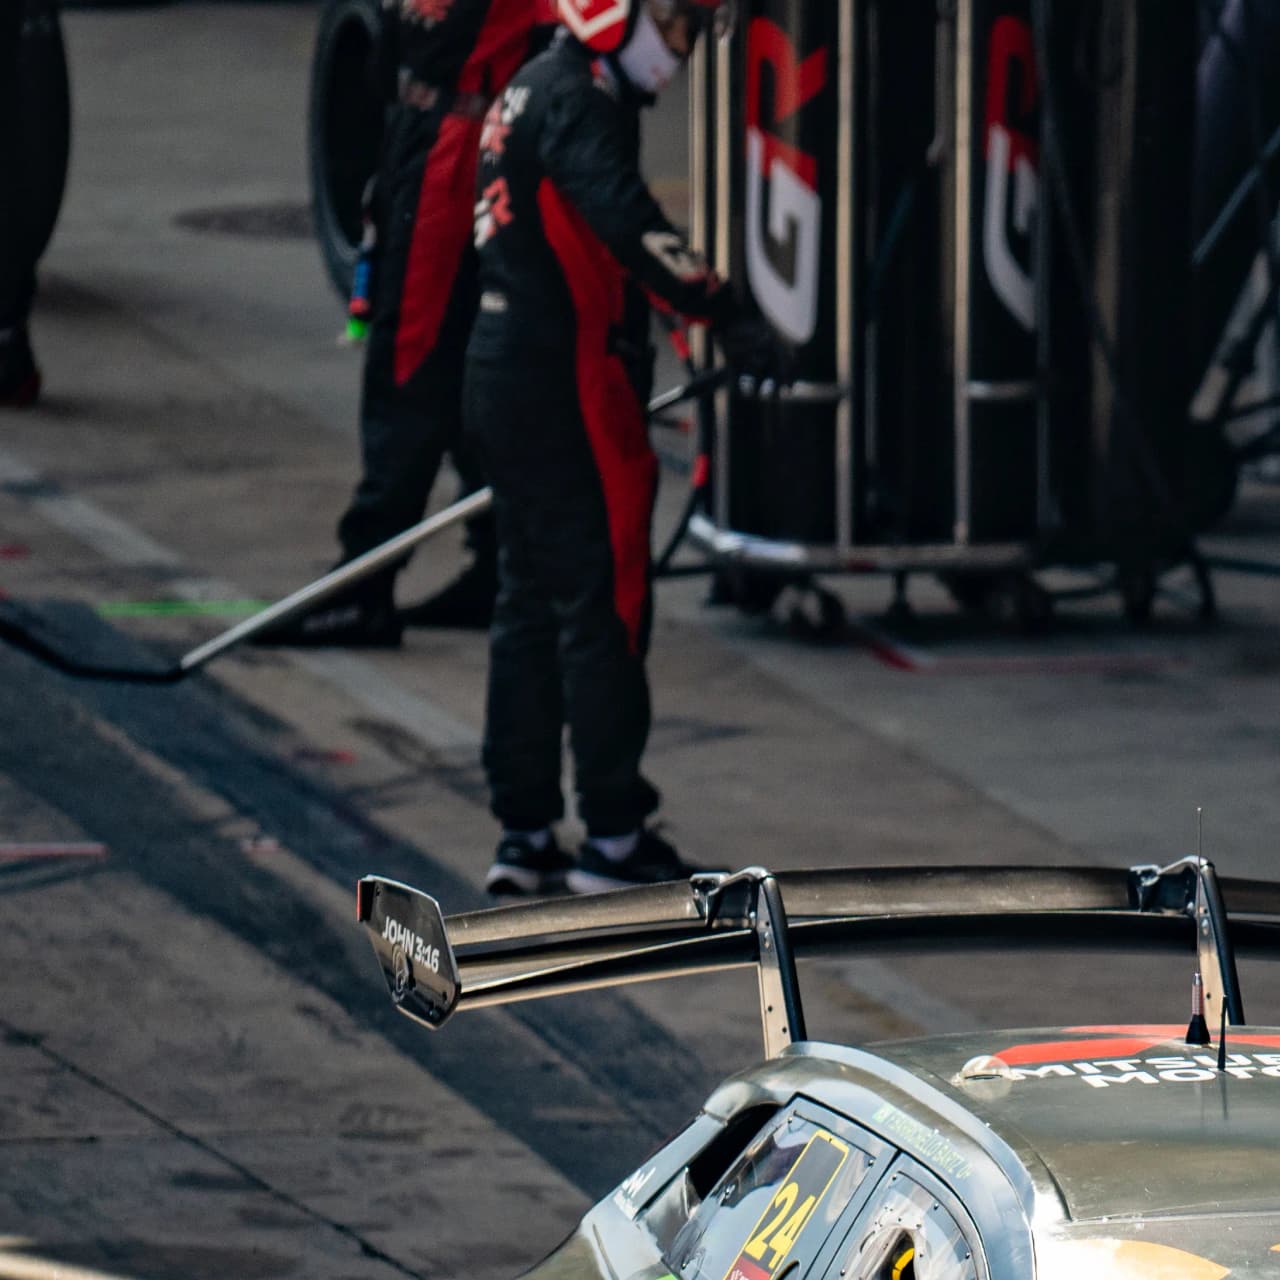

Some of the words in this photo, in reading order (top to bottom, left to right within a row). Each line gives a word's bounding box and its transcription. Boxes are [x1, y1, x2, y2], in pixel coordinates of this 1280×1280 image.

[382, 915, 415, 957] JOHN
[415, 936, 440, 974] 3:16
[744, 1181, 816, 1270] 24
